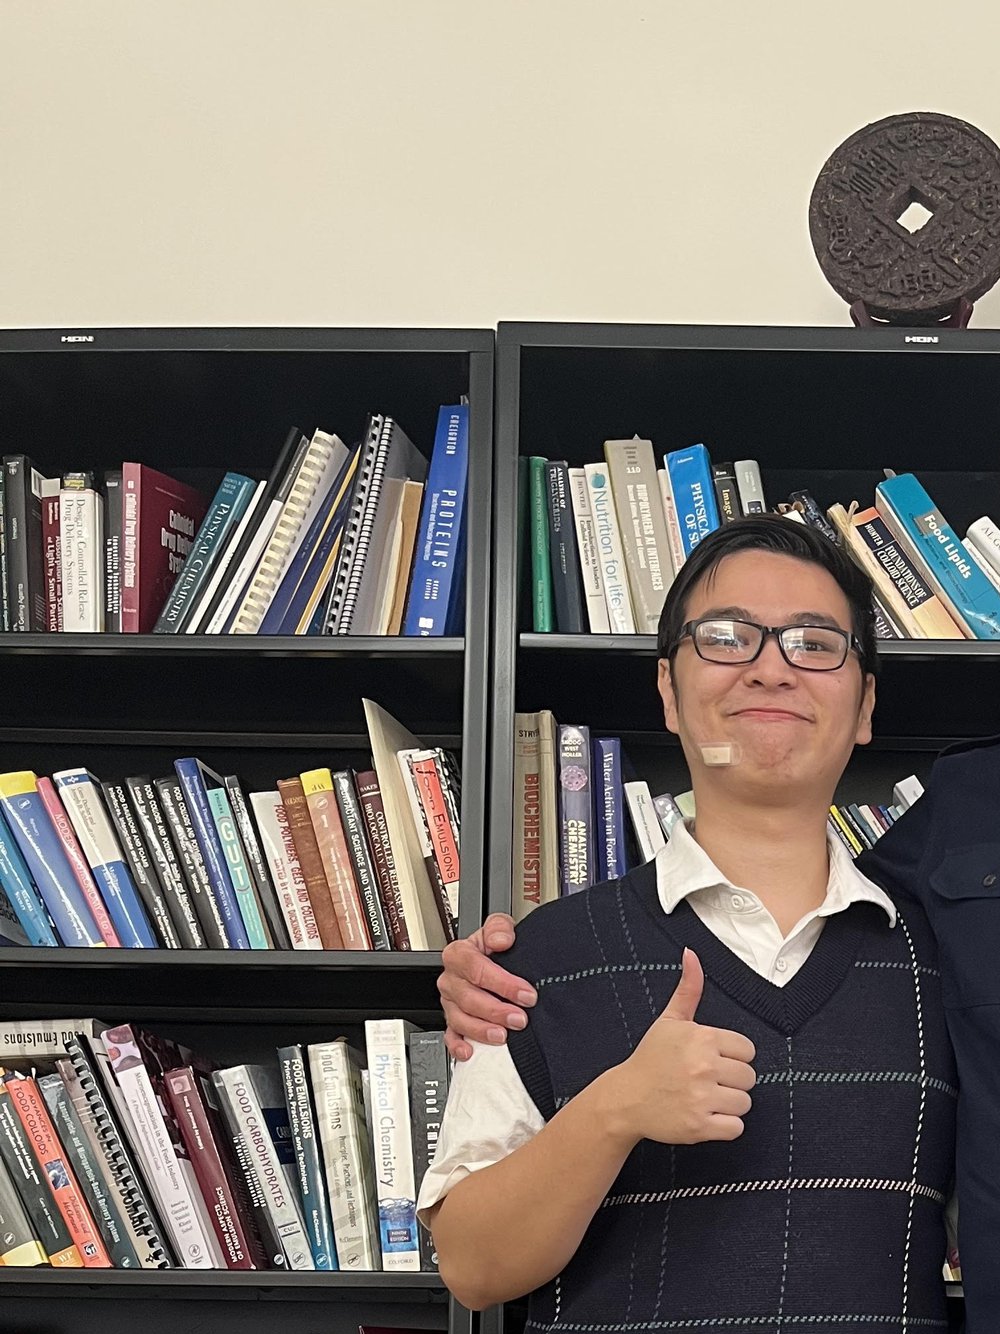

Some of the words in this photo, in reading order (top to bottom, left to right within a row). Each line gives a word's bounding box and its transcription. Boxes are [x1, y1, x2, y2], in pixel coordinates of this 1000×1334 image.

[446, 415, 459, 455] CREIGHTON
[557, 467, 565, 498] ANALYSIS
[64, 499, 75, 521] Drug
[75, 499, 85, 527] Design
[549, 467, 560, 533] TRIGLYCERIDES
[560, 500, 566, 509] OF
[636, 484, 653, 535] BIOPOLYMERS
[722, 489, 733, 514] Image
[125, 520, 136, 535] Drug
[198, 503, 230, 556] PHYSICAL
[431, 490, 457, 568] PROTEINS
[579, 520, 588, 541] Colloid
[593, 491, 615, 555] Nutrition
[685, 513, 697, 531] OF
[864, 523, 884, 547] HUNTER
[981, 527, 993, 537] AL
[46, 545, 55, 566] Light
[64, 524, 75, 558] Delivery
[582, 542, 590, 566] Science
[586, 520, 599, 558] Introduction
[645, 537, 656, 546] AT
[924, 514, 950, 544] Food
[944, 543, 972, 579] Lipids
[67, 561, 77, 595] Systems
[77, 541, 87, 586] Controlled
[124, 562, 135, 587] Systems
[592, 565, 601, 590] Modern
[605, 560, 619, 581] for
[646, 547, 664, 591] INTERFACES
[877, 550, 901, 584] COLLOID
[895, 575, 920, 607] SCIENCE
[885, 545, 919, 588] FOUNDATIONS
[48, 578, 56, 601] Small
[79, 589, 89, 620] Release
[166, 559, 204, 625] CHEMISTRY
[608, 584, 624, 606] life
[603, 752, 614, 783] Water
[144, 785, 154, 799] FOOD
[173, 787, 185, 801] FOOD
[603, 784, 616, 820] Activity
[115, 786, 125, 803] FOOD
[121, 803, 136, 834] EMULSIONS
[132, 835, 141, 847] AND
[138, 847, 148, 868] FOAMS
[150, 799, 165, 824] COLLOIDS
[178, 802, 192, 826] COLLOIDS
[274, 804, 287, 822] FOOD
[156, 825, 166, 836] AND
[185, 827, 195, 838] AND
[281, 826, 299, 864] POLYMERS,
[523, 773, 541, 905] BIOCHEMISTRY
[605, 823, 616, 835] in
[351, 834, 365, 867] SCIENCE
[375, 811, 395, 868] CONTROLLED
[388, 869, 404, 906] RELEASE
[432, 813, 456, 879] EMULSIONS
[567, 819, 579, 885] CHEMISTRY
[576, 820, 587, 884] ANALYTICAL
[605, 837, 617, 870] Foods
[291, 866, 304, 884] GELS
[359, 869, 369, 884] AND
[364, 802, 384, 864] BIOLOGICALLY
[379, 868, 392, 898] ACTIVE
[386, 899, 400, 934] AGENTS
[297, 889, 308, 902] AND
[363, 887, 381, 936] TECHNOLOGY
[287, 910, 304, 944] DICKINSON
[301, 906, 318, 940] COLLOIDS
[283, 1059, 295, 1100] Principles,
[291, 1058, 304, 1085] FOOD
[375, 1053, 391, 1111] Physical
[295, 1086, 311, 1139] EMULSIONS
[322, 1076, 343, 1131] Emulsions
[424, 1081, 439, 1114] Food
[13, 1087, 30, 1112] FOOD
[26, 1114, 49, 1155] COLLOIDS
[29, 1094, 49, 1134] ADVANCES
[44, 1134, 52, 1142] IN
[289, 1101, 300, 1135] Practice,
[160, 1149, 172, 1164] Food
[233, 1082, 251, 1113] FOOD
[245, 1117, 286, 1208] CARBOHYDRATES
[295, 1136, 304, 1151] and
[379, 1116, 397, 1189] Chemistry
[164, 1164, 181, 1191] Industry
[297, 1152, 310, 1196] Techniques
[215, 1187, 229, 1216] SCIENCE
[106, 1221, 120, 1243] Systems
[214, 1204, 228, 1234] ASPECTS
[225, 1217, 241, 1250] EMULSION
[311, 1209, 322, 1247] McClements
[223, 1236, 237, 1263] MODERN
